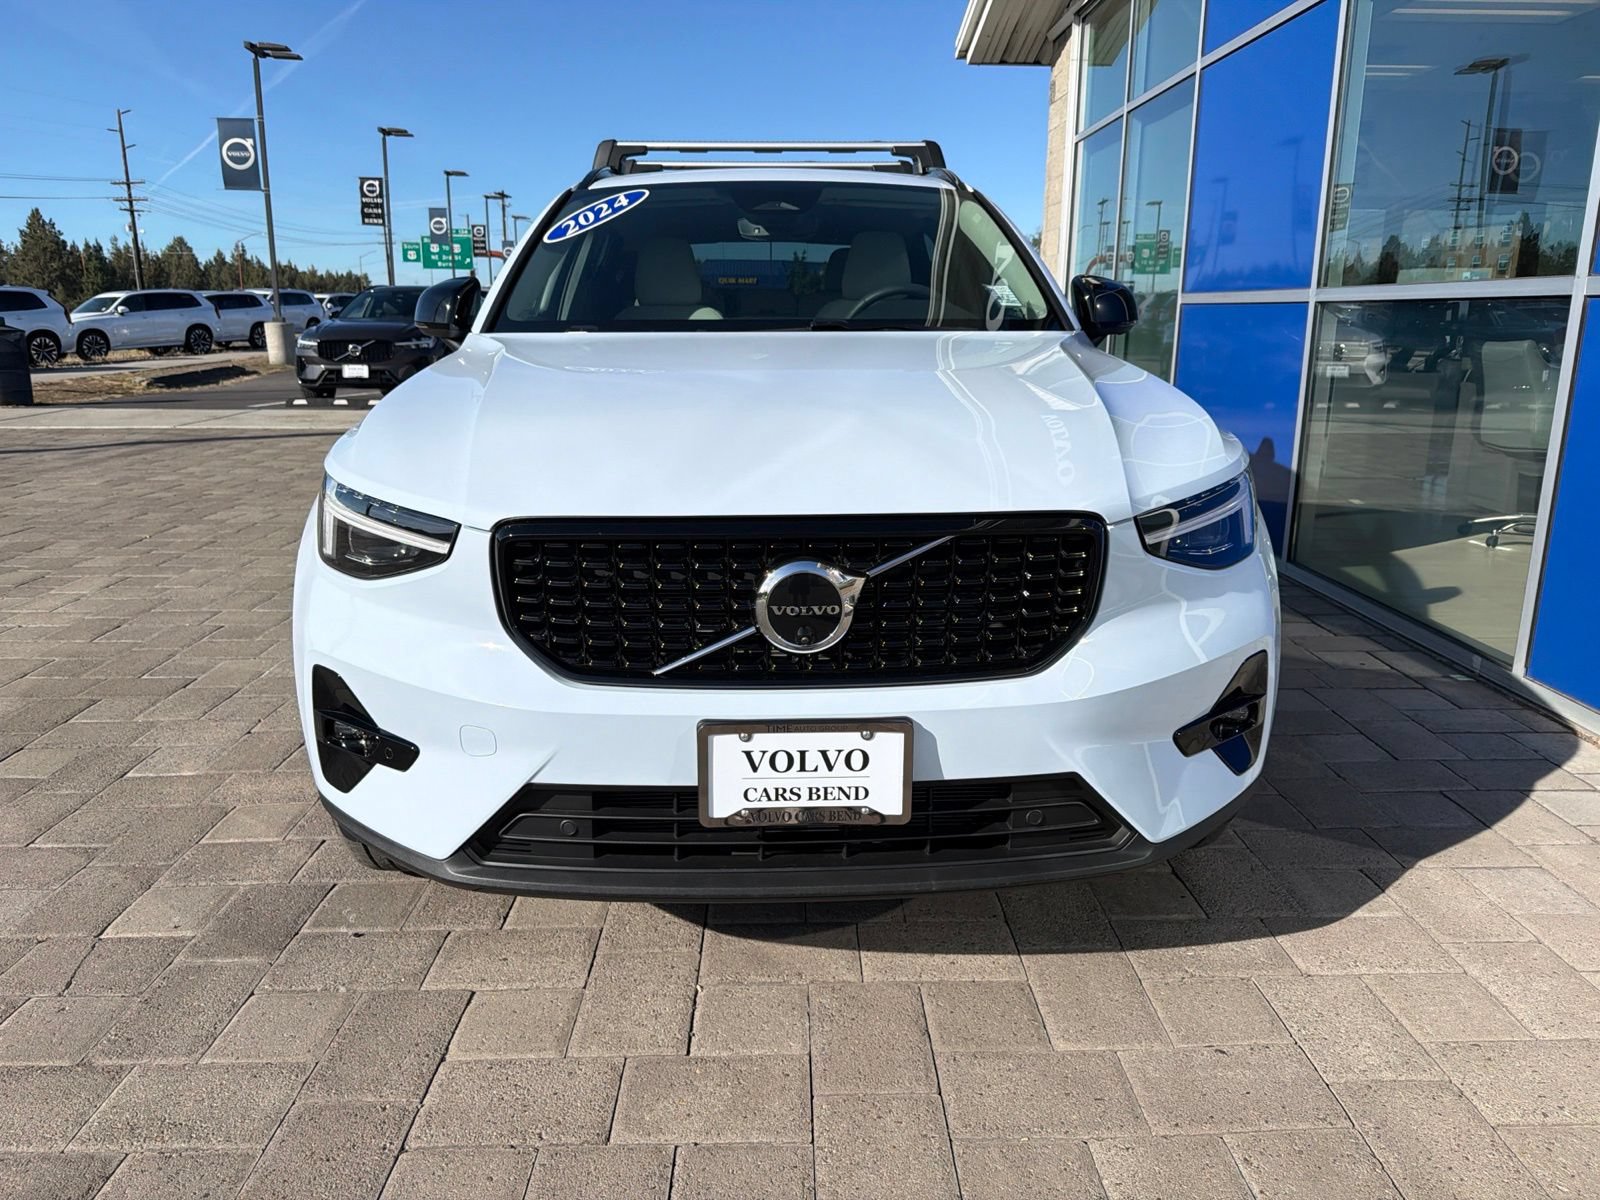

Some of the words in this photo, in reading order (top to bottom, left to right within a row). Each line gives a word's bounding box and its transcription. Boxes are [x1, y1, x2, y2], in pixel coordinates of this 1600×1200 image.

[561, 193, 629, 237] 2024
[769, 605, 840, 616] VOLVO
[767, 724, 792, 733] TIME
[741, 748, 870, 773] VOLVO
[743, 786, 802, 802] CARS
[806, 786, 870, 801] BEND
[750, 811, 793, 823] VOLVO
[795, 811, 826, 822] CARS
[829, 810, 862, 822] BEND
